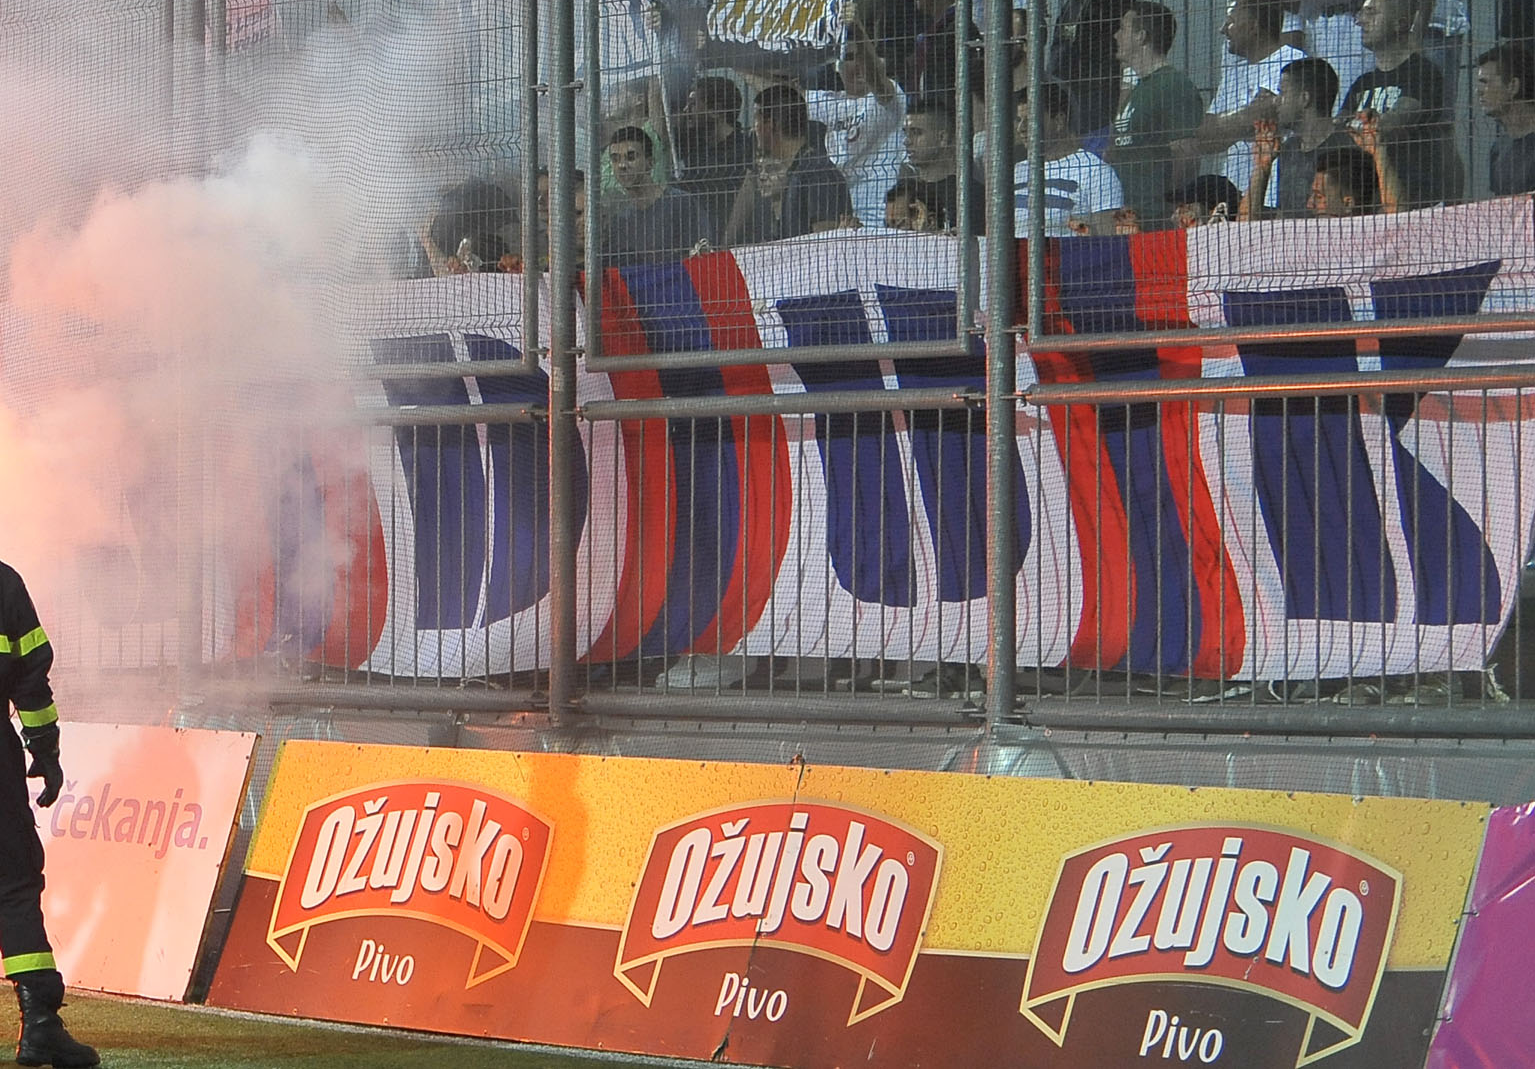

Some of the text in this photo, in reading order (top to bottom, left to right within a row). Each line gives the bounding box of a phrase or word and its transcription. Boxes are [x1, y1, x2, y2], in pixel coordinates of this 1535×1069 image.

[50, 779, 209, 860] čekanja.
[300, 791, 524, 920] Ožujsko
[651, 812, 910, 952] Ožujsko
[1062, 837, 1364, 989] Ožujsko
[351, 939, 414, 986] Pivo
[714, 972, 788, 1022] Pivo
[1139, 1009, 1223, 1063] Pivo
